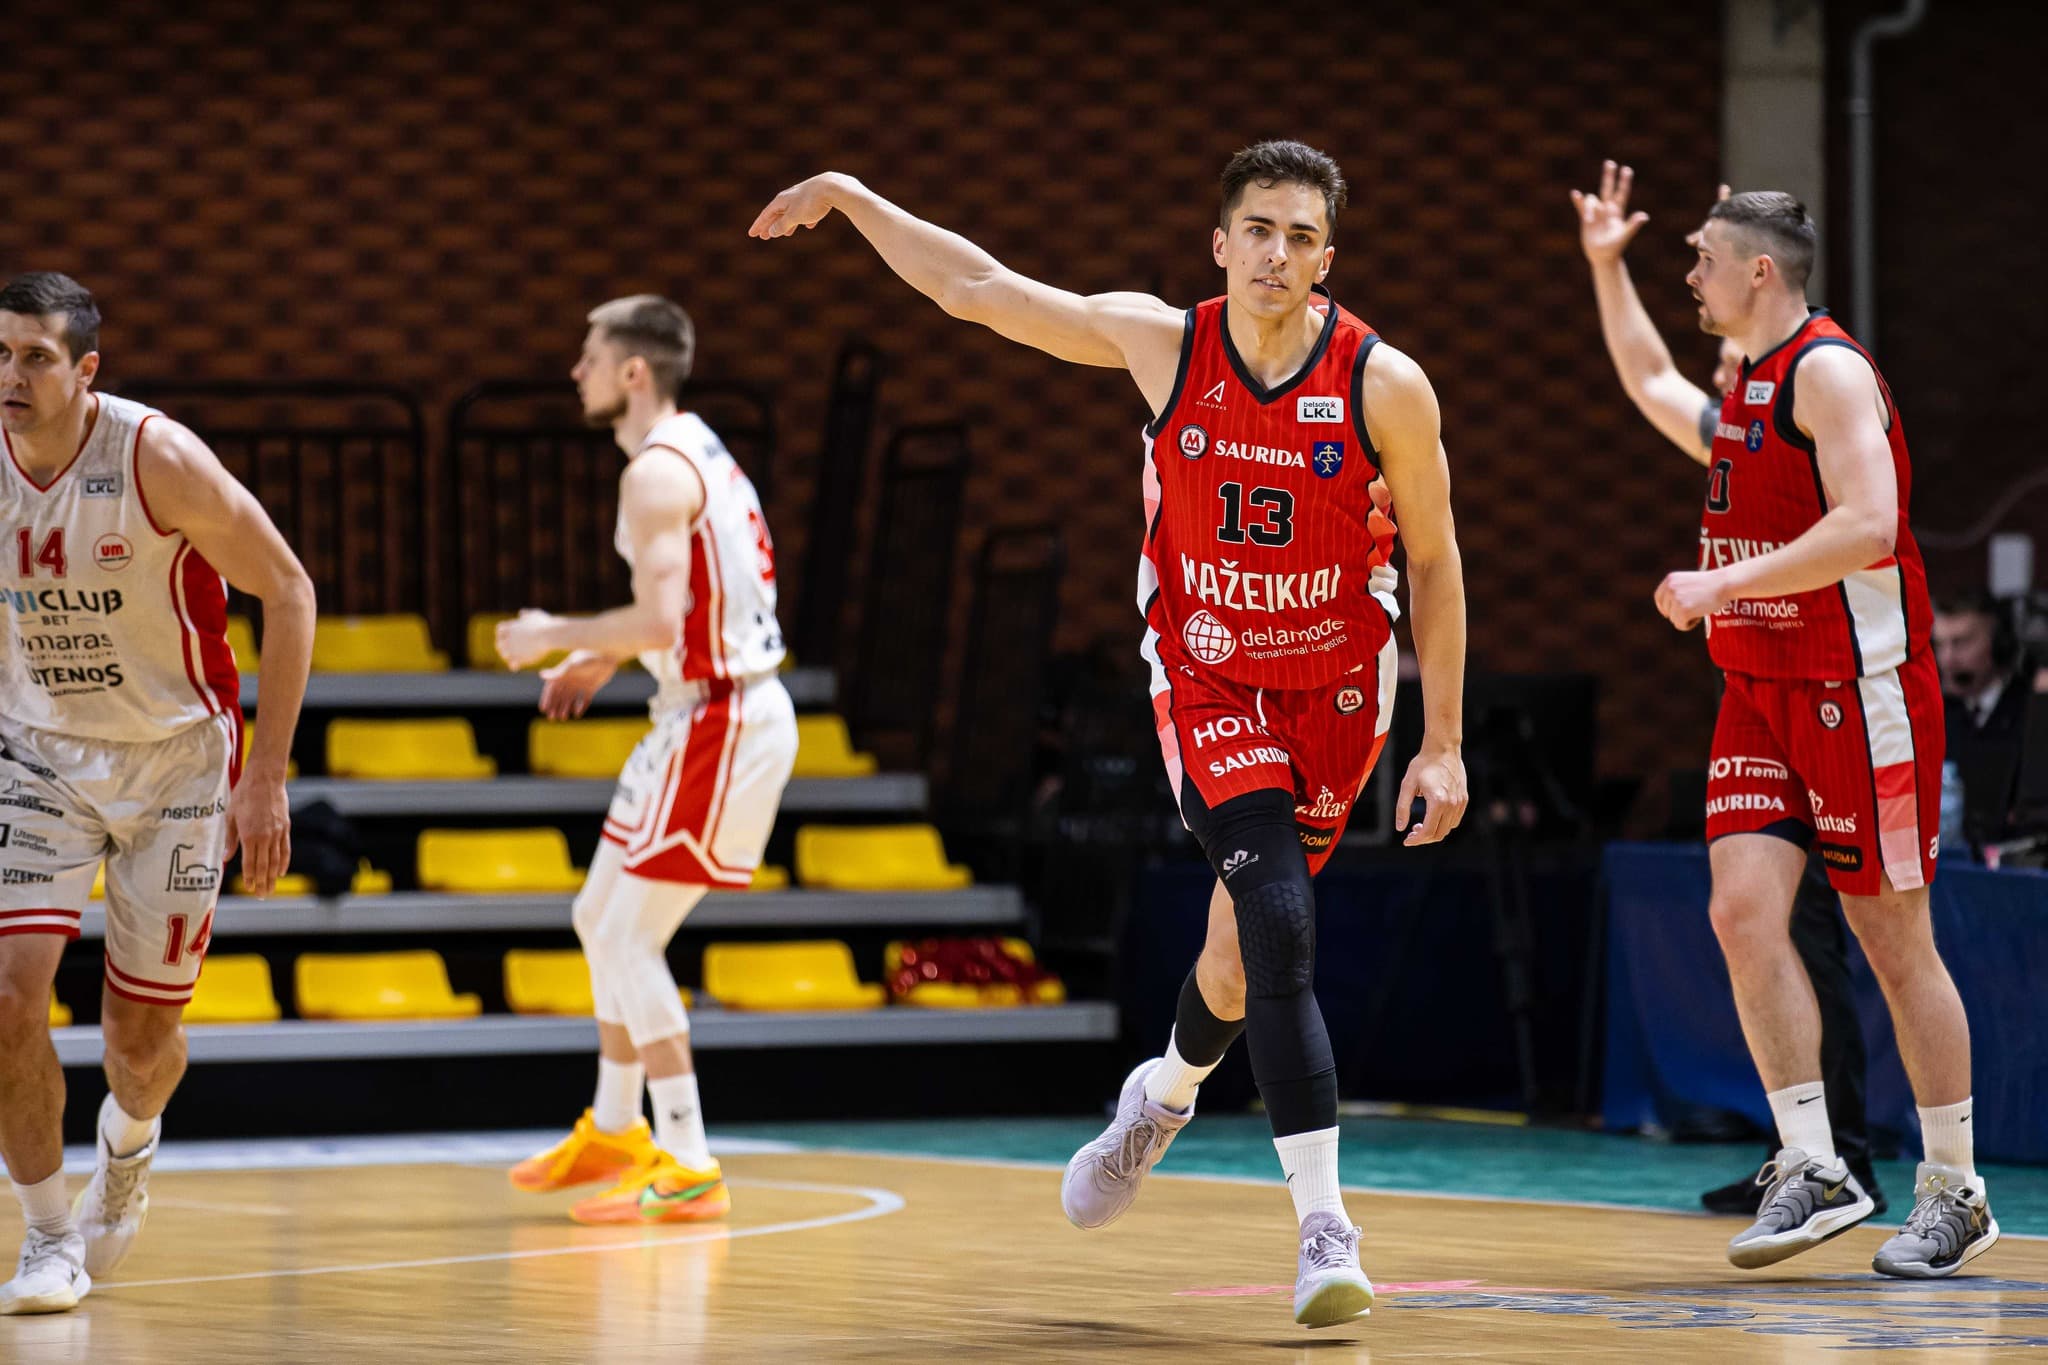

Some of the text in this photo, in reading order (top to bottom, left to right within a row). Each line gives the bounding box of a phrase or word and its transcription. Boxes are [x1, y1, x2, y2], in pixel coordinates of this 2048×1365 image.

[1303, 407, 1337, 418] LKL
[1214, 439, 1306, 468] SAURIDA
[1217, 481, 1295, 548] 13
[17, 526, 68, 578] 14
[41, 615, 69, 625] BET
[1713, 598, 1799, 618] elamode
[20, 633, 113, 652] maras
[1241, 618, 1345, 647] delamode
[1311, 634, 1348, 652] Logistics
[26, 663, 124, 687] UTENOS
[163, 908, 214, 966] 14
